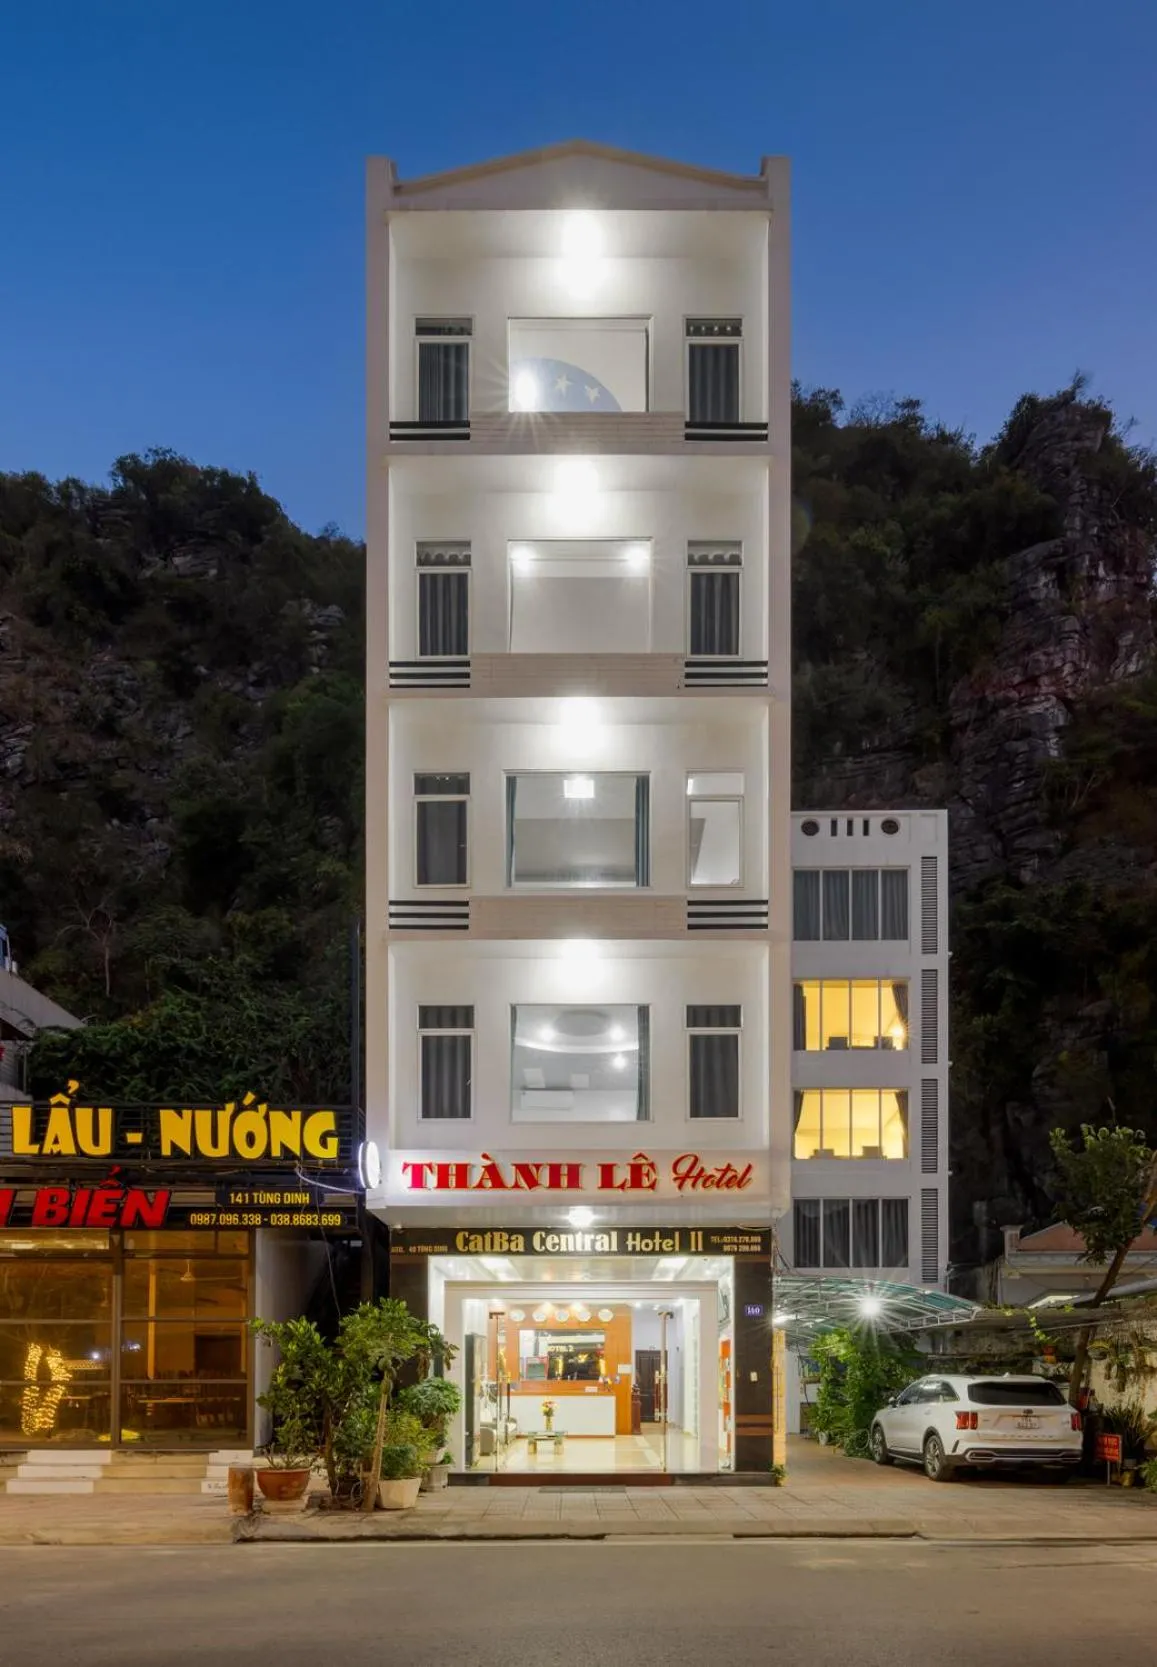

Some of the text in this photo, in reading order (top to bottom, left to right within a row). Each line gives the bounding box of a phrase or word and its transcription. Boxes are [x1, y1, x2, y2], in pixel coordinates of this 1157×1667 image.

[11, 1079, 113, 1156] LẨU
[159, 1091, 339, 1159] NƯỚNG
[402, 1152, 753, 1192] THÀNH LÊ Hotel
[229, 1192, 249, 1204] 141
[252, 1190, 281, 1204] TÙNG
[190, 1213, 262, 1225] 0987.096.338
[270, 1213, 341, 1226] 038.8683.699
[455, 1231, 525, 1253] CatBa
[532, 1231, 618, 1253] Central
[626, 1232, 680, 1253] Hotel
